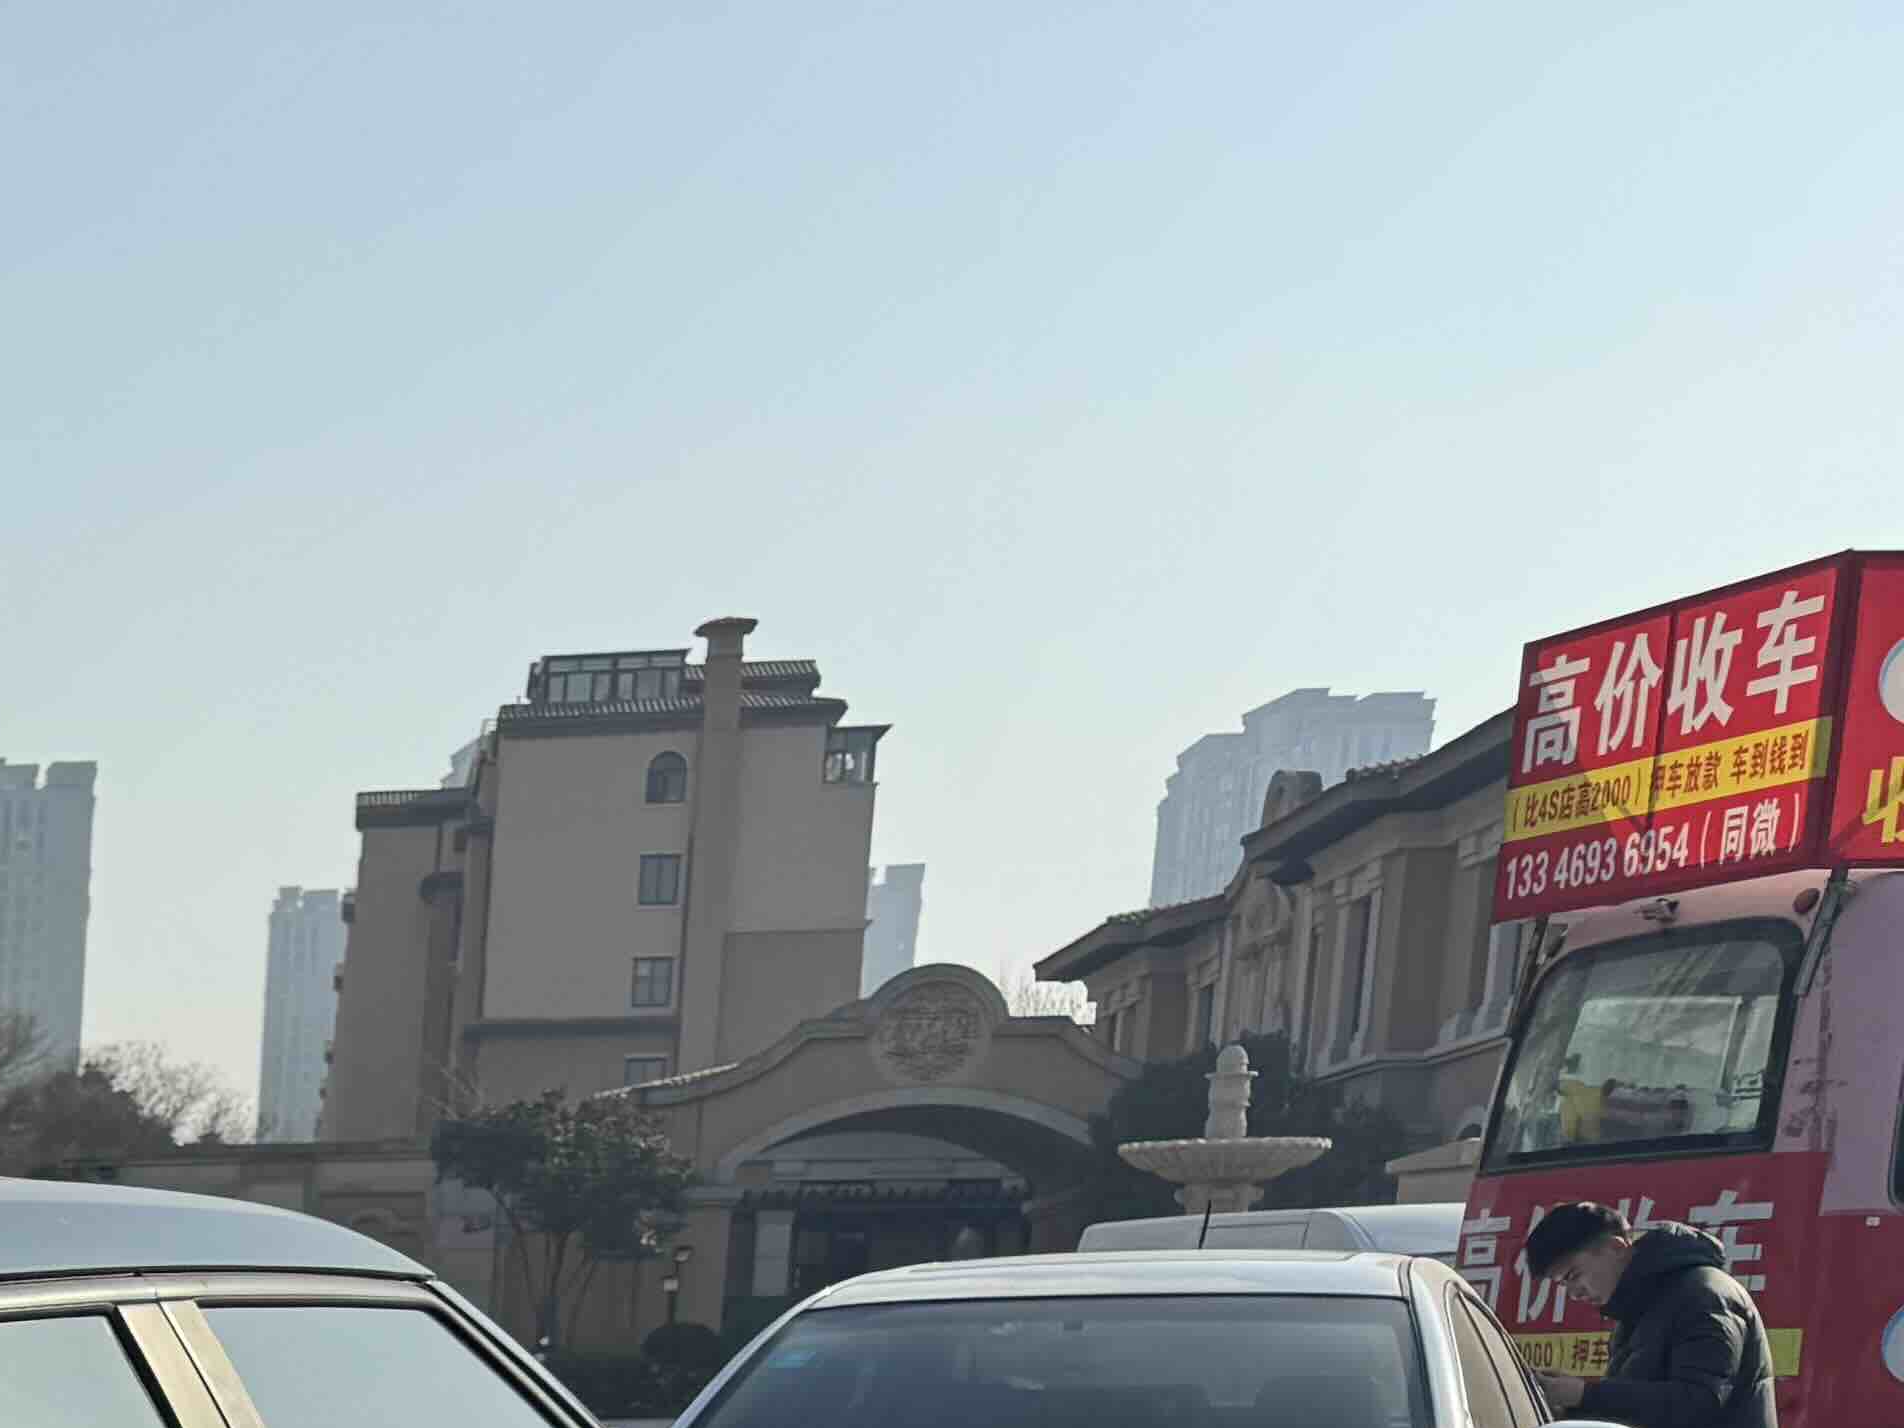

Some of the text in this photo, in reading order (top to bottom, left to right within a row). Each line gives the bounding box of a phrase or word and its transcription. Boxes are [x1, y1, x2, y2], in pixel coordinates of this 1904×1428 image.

[1521, 589, 1826, 775] 高价收车
[1505, 849, 1551, 900] 133
[1552, 836, 1617, 891] 4693
[1623, 821, 1690, 878] 6954
